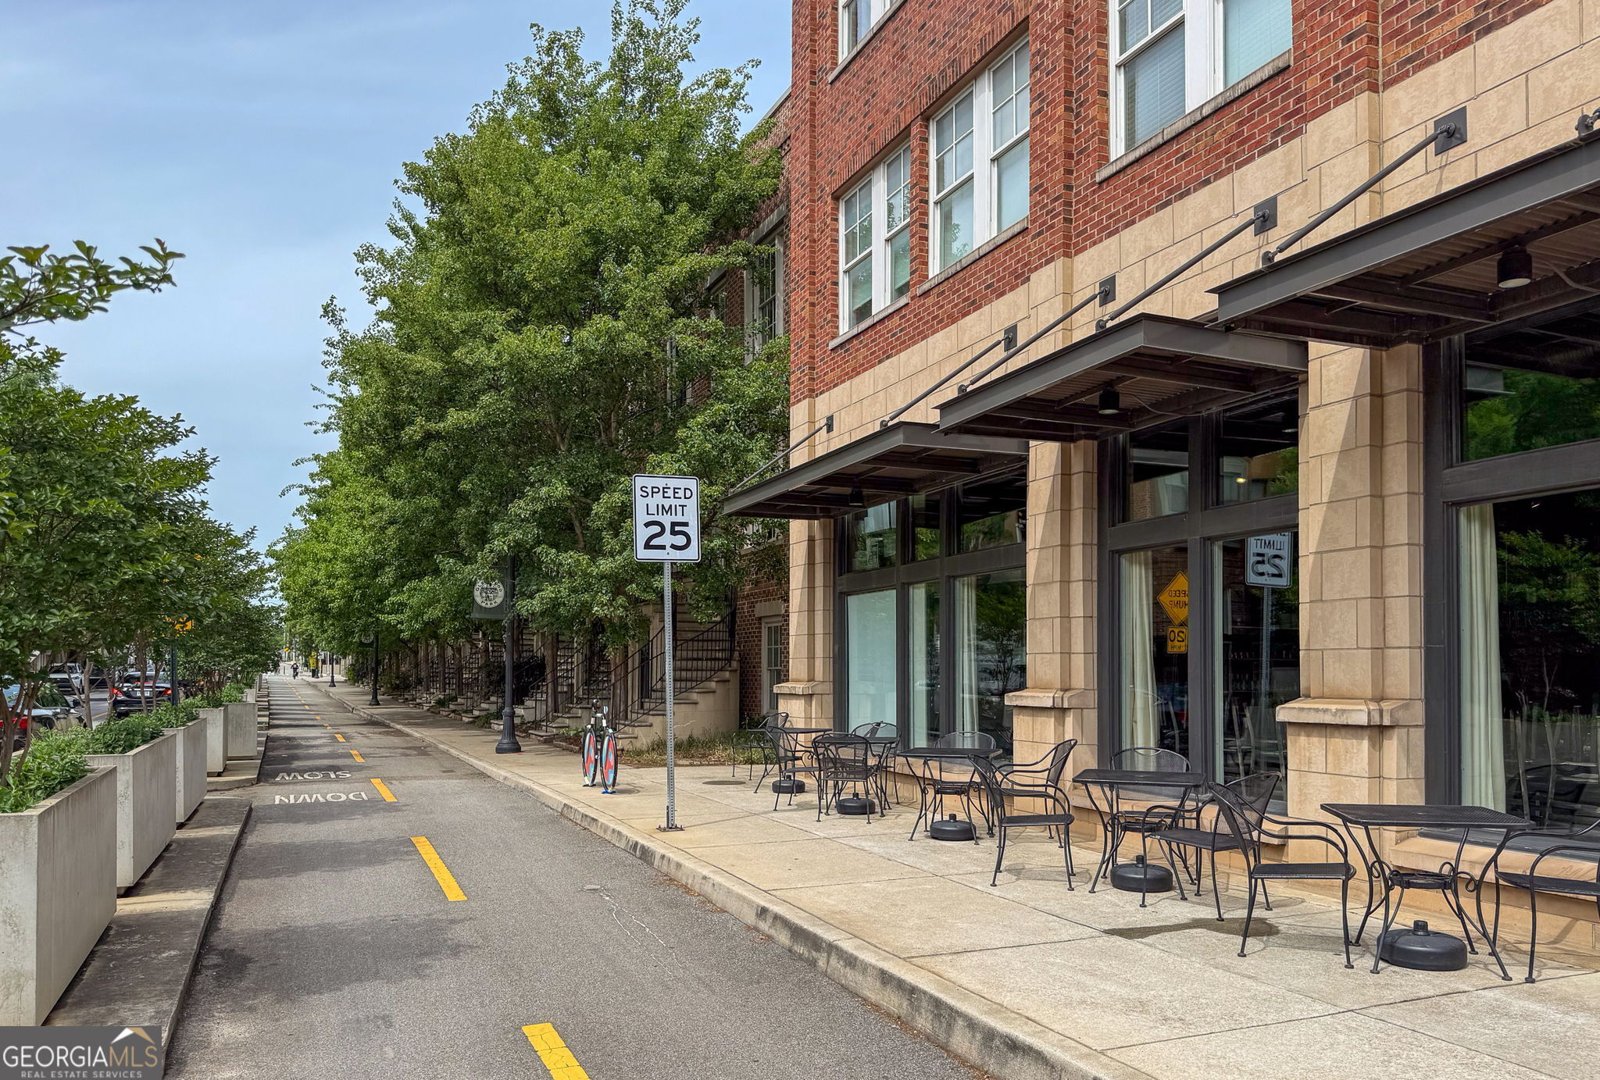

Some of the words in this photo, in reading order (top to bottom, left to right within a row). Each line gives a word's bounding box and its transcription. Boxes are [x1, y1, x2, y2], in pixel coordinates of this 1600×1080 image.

[640, 486, 693, 499] SPEED
[646, 503, 687, 516] LIMIT
[643, 520, 692, 551] 25
[275, 771, 351, 780] SLOW
[275, 792, 368, 804] DOWN
